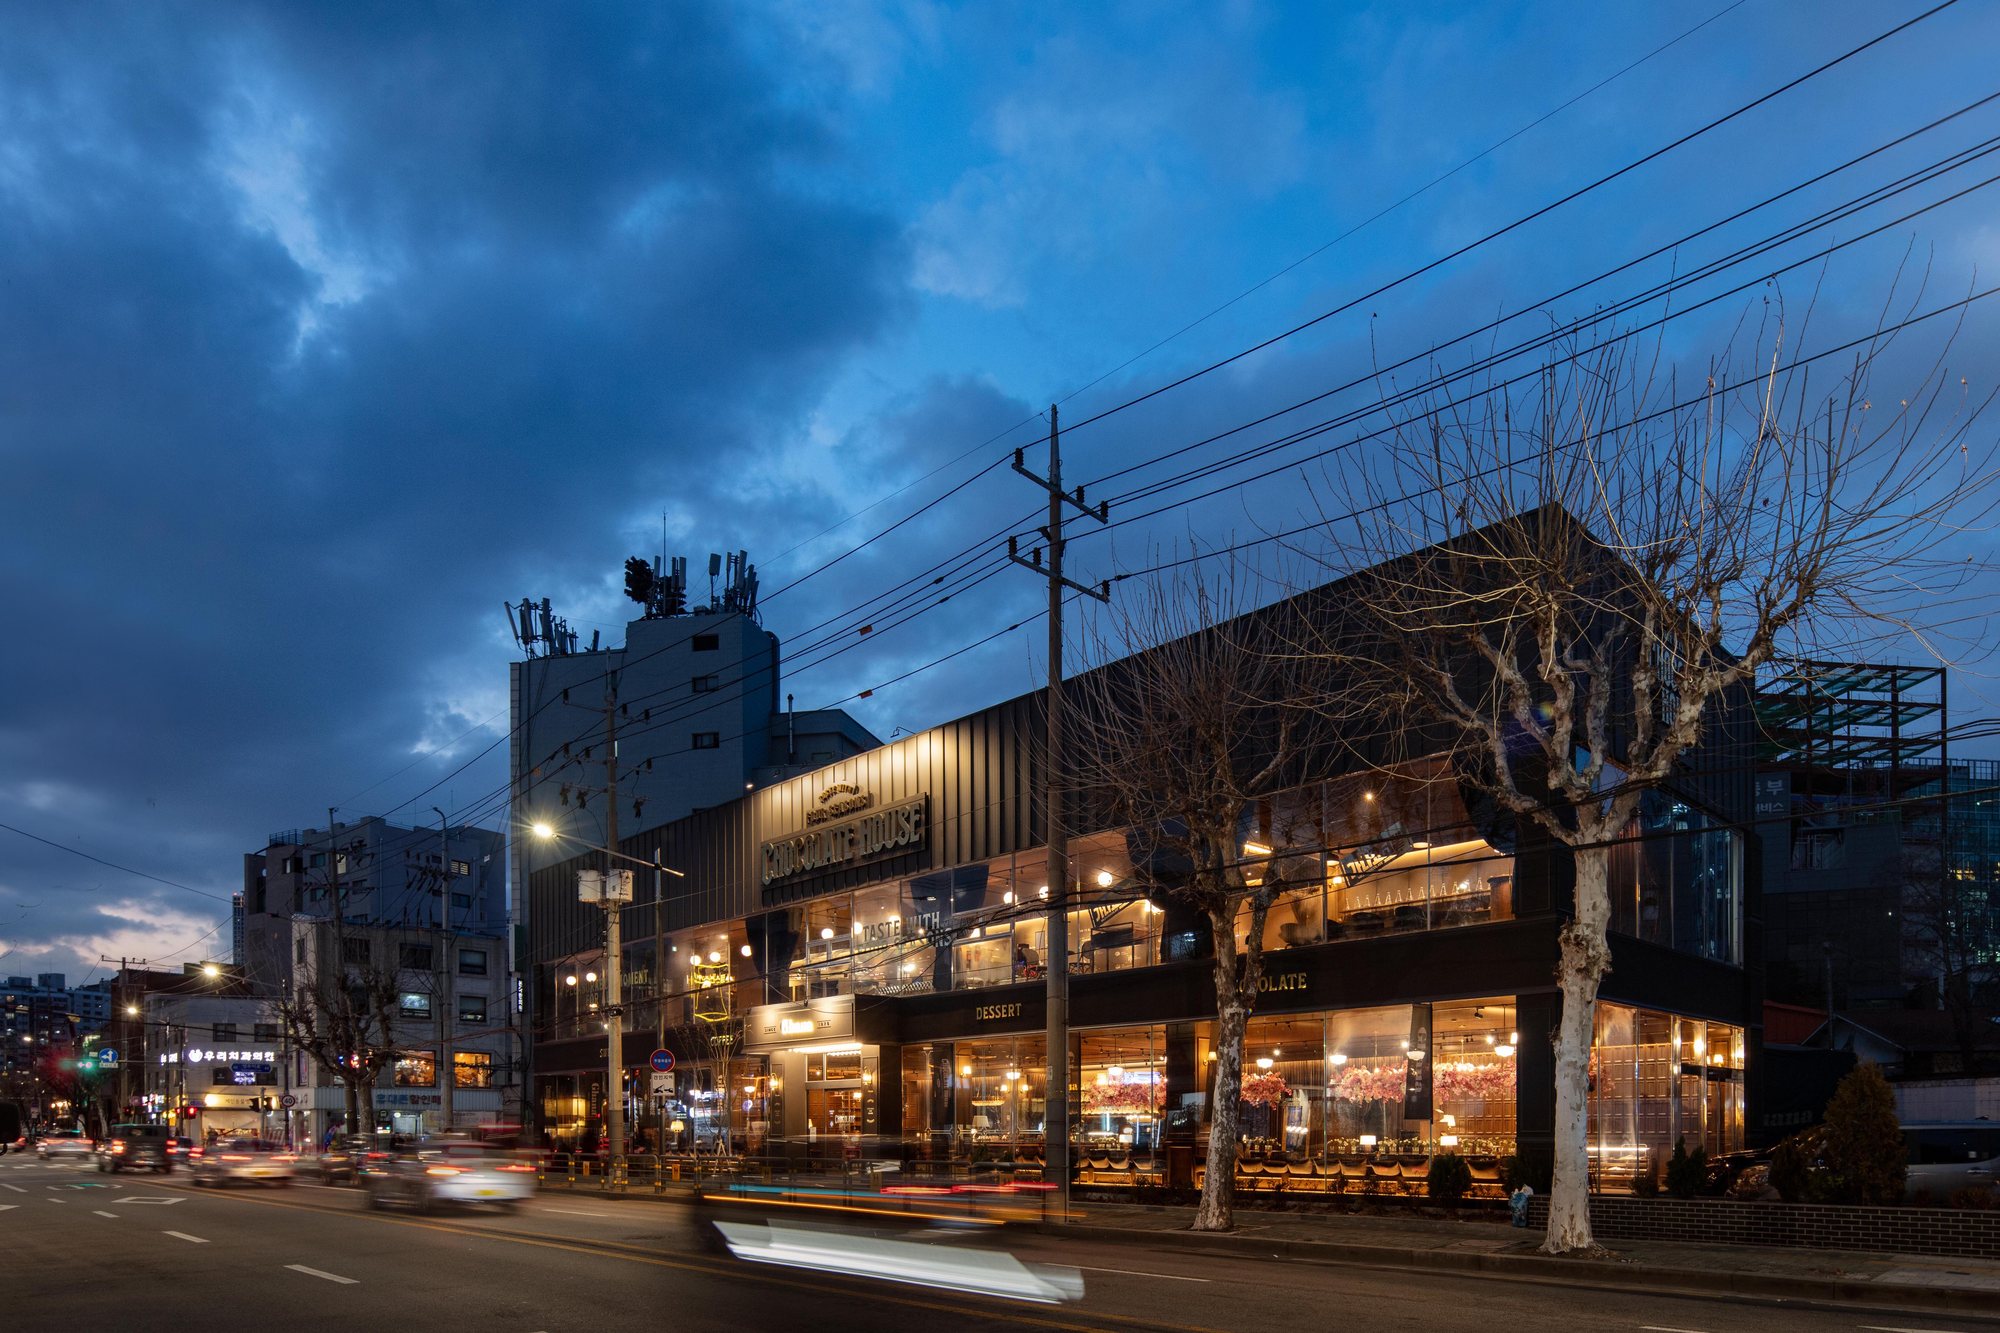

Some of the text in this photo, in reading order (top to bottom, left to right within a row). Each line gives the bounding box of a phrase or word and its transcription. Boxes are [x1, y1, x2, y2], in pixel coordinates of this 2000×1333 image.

[761, 802, 922, 886] CHOCOLATE HOUSE
[863, 911, 940, 942] TASTE WITH
[622, 969, 649, 987] OMENT
[976, 1003, 1023, 1020] DESSERT
[710, 1035, 734, 1047] COFFEE
[203, 1050, 275, 1062] 우리치과의원
[284, 1097, 293, 1105] 40
